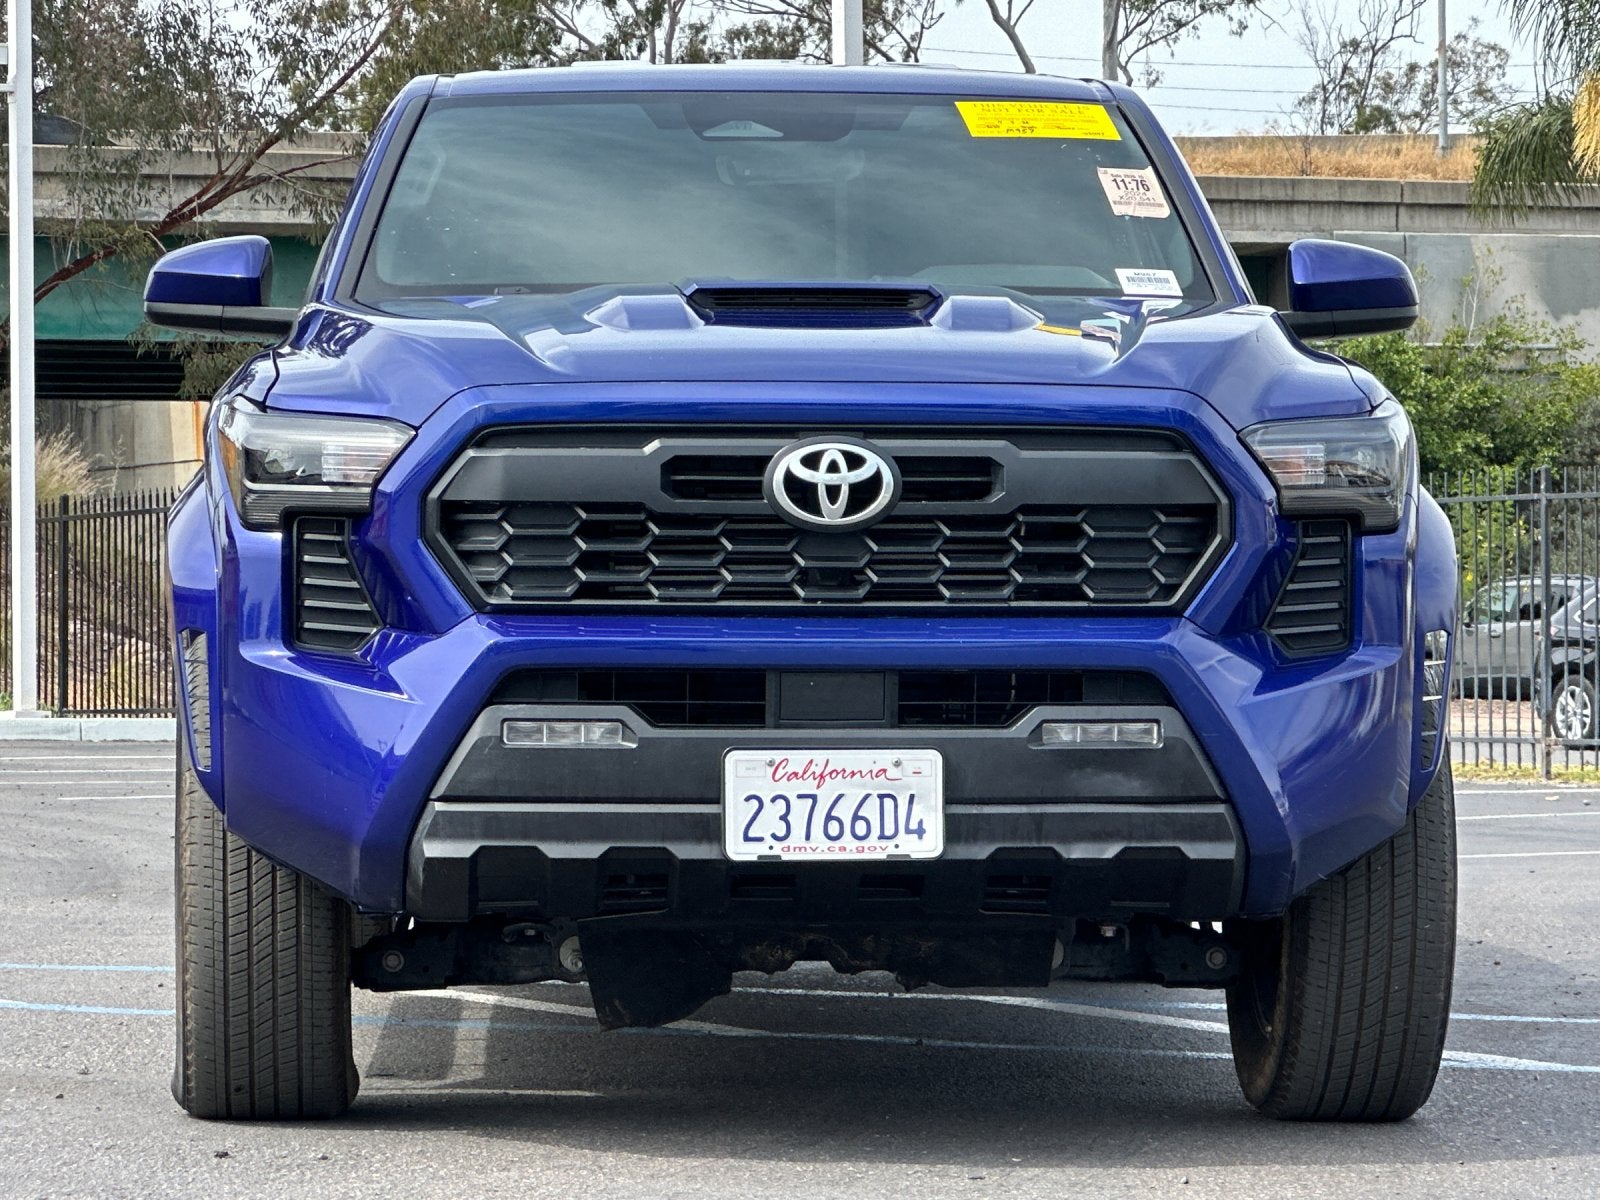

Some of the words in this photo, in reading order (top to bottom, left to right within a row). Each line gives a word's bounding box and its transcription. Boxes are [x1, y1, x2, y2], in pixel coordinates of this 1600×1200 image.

[1111, 178, 1150, 192] 11:76
[772, 758, 902, 789] California
[742, 793, 926, 842] 23766D4
[781, 844, 889, 854] dmv.ca.gov
